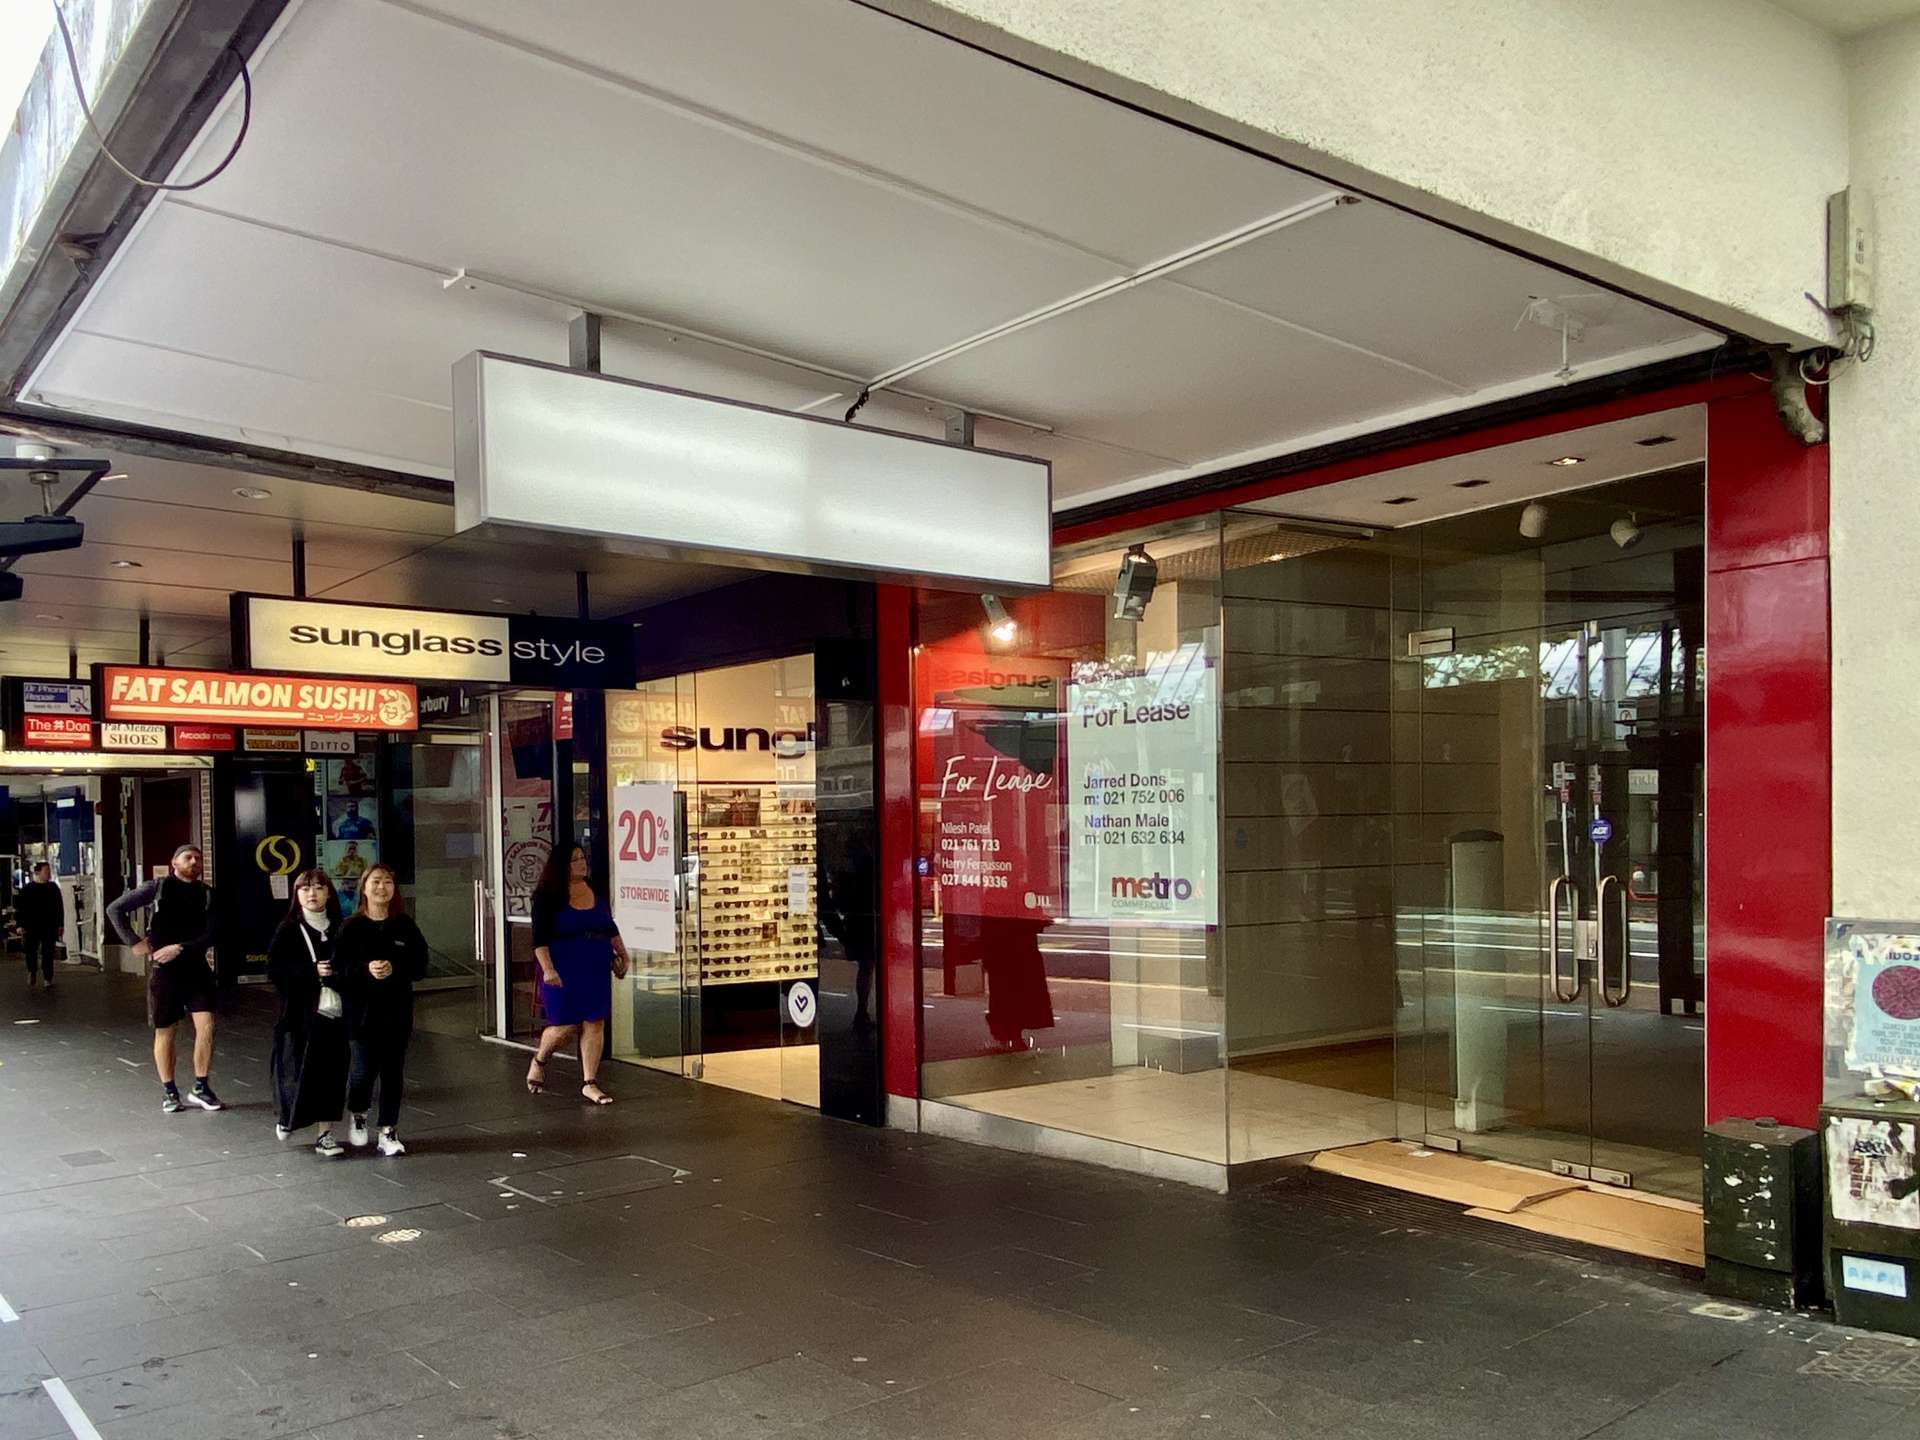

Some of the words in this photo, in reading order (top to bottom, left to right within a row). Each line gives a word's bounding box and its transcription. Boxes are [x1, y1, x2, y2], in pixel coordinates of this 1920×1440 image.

[289, 625, 503, 655] sunglass
[513, 638, 605, 666] style
[112, 675, 167, 702] FAT
[169, 678, 293, 707] SALMON
[297, 685, 376, 711] SUSHI
[1084, 705, 1120, 728] For
[1122, 701, 1190, 724] Lease
[28, 718, 51, 731] The
[66, 721, 90, 733] Don
[109, 734, 158, 746] SHOES
[310, 740, 349, 751] DITTO
[941, 755, 977, 798] For
[983, 755, 1053, 801] Lease
[1084, 774, 1126, 789] Jarred
[1130, 773, 1167, 788] Dons
[1103, 791, 1125, 806] 021
[1131, 790, 1155, 804] 752
[1159, 789, 1184, 803] 006
[942, 822, 967, 834] Nilesh
[969, 823, 991, 835] Patel
[1084, 814, 1131, 829] Nathan
[1135, 813, 1169, 828] Male
[942, 838, 959, 850] 021
[1104, 831, 1126, 845] 021
[1131, 831, 1155, 845] 632
[942, 858, 965, 871] Harry
[942, 874, 959, 886] 027
[1111, 872, 1192, 900] metro
[620, 886, 670, 902] STOREWIDE
